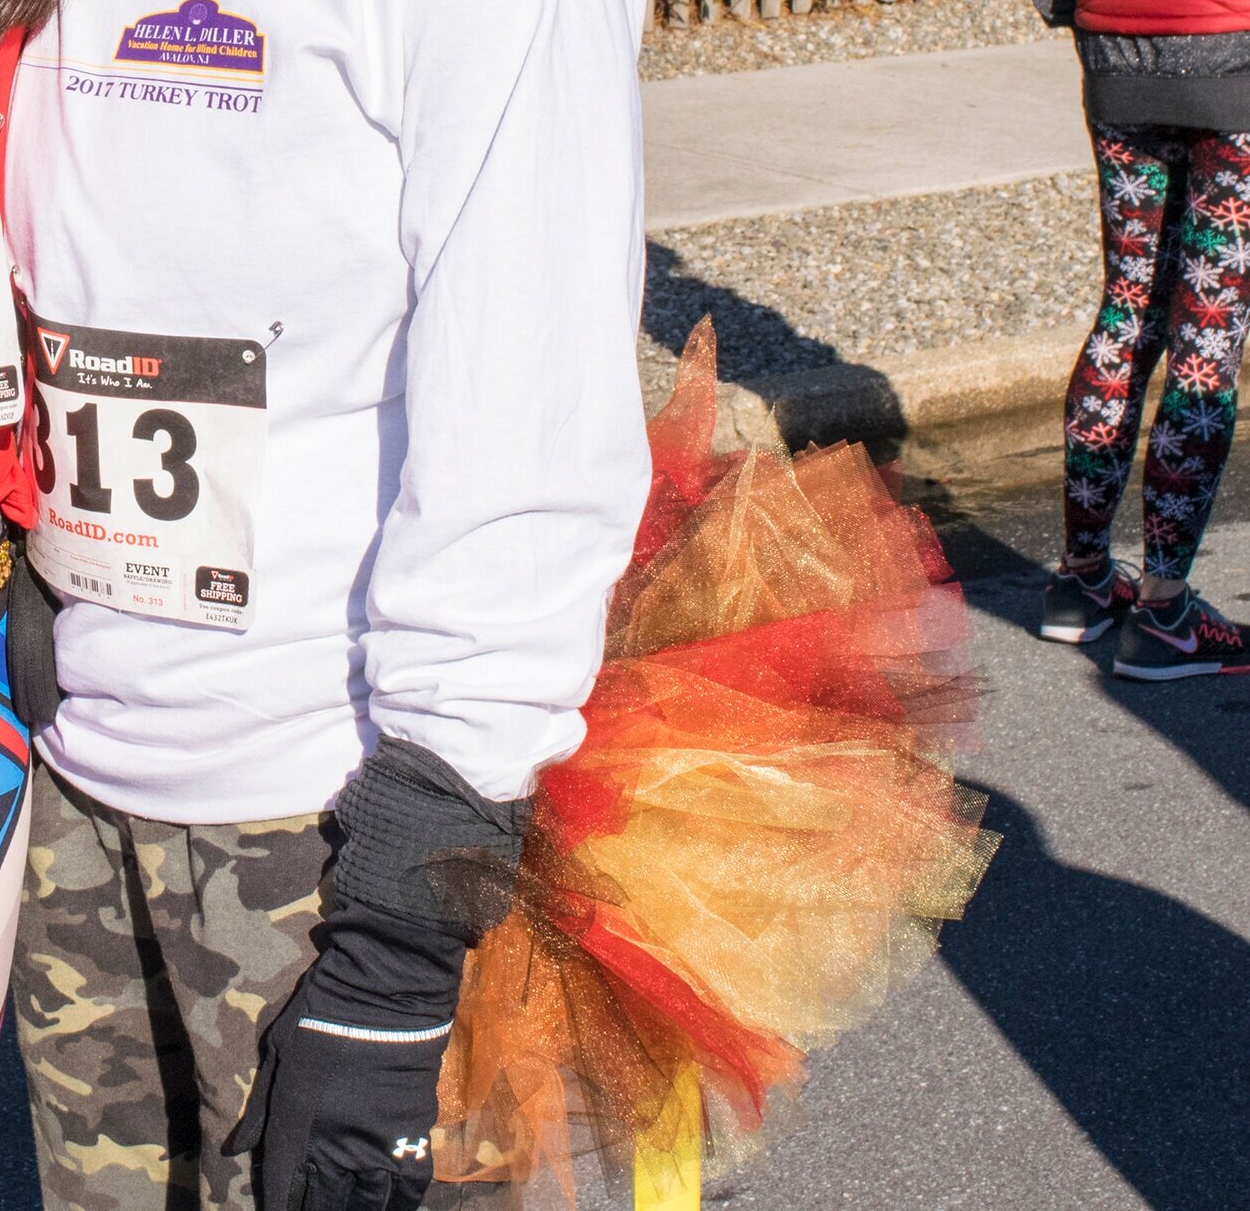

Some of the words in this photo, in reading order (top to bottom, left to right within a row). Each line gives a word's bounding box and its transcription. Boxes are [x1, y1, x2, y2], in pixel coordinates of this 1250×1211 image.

[134, 24, 183, 40] HELEN
[184, 27, 196, 42] L.
[200, 28, 255, 45] DILLER
[128, 39, 158, 50] Vacation
[160, 42, 184, 52] Home
[185, 43, 196, 53] for
[196, 43, 217, 54] Blind
[219, 45, 257, 58] Children
[66, 75, 114, 98] 2017
[118, 82, 198, 107] TURKEY
[205, 91, 262, 113] TROT
[69, 349, 160, 377] RoadID
[77, 372, 97, 384] It's
[101, 375, 120, 387] Who
[124, 377, 133, 388] I
[48, 507, 159, 548] RoadID.com
[125, 562, 170, 578] EVENT
[210, 580, 236, 593] FREE
[133, 594, 147, 604] No.
[149, 596, 163, 607] 313
[200, 588, 243, 603] SHIPPING
